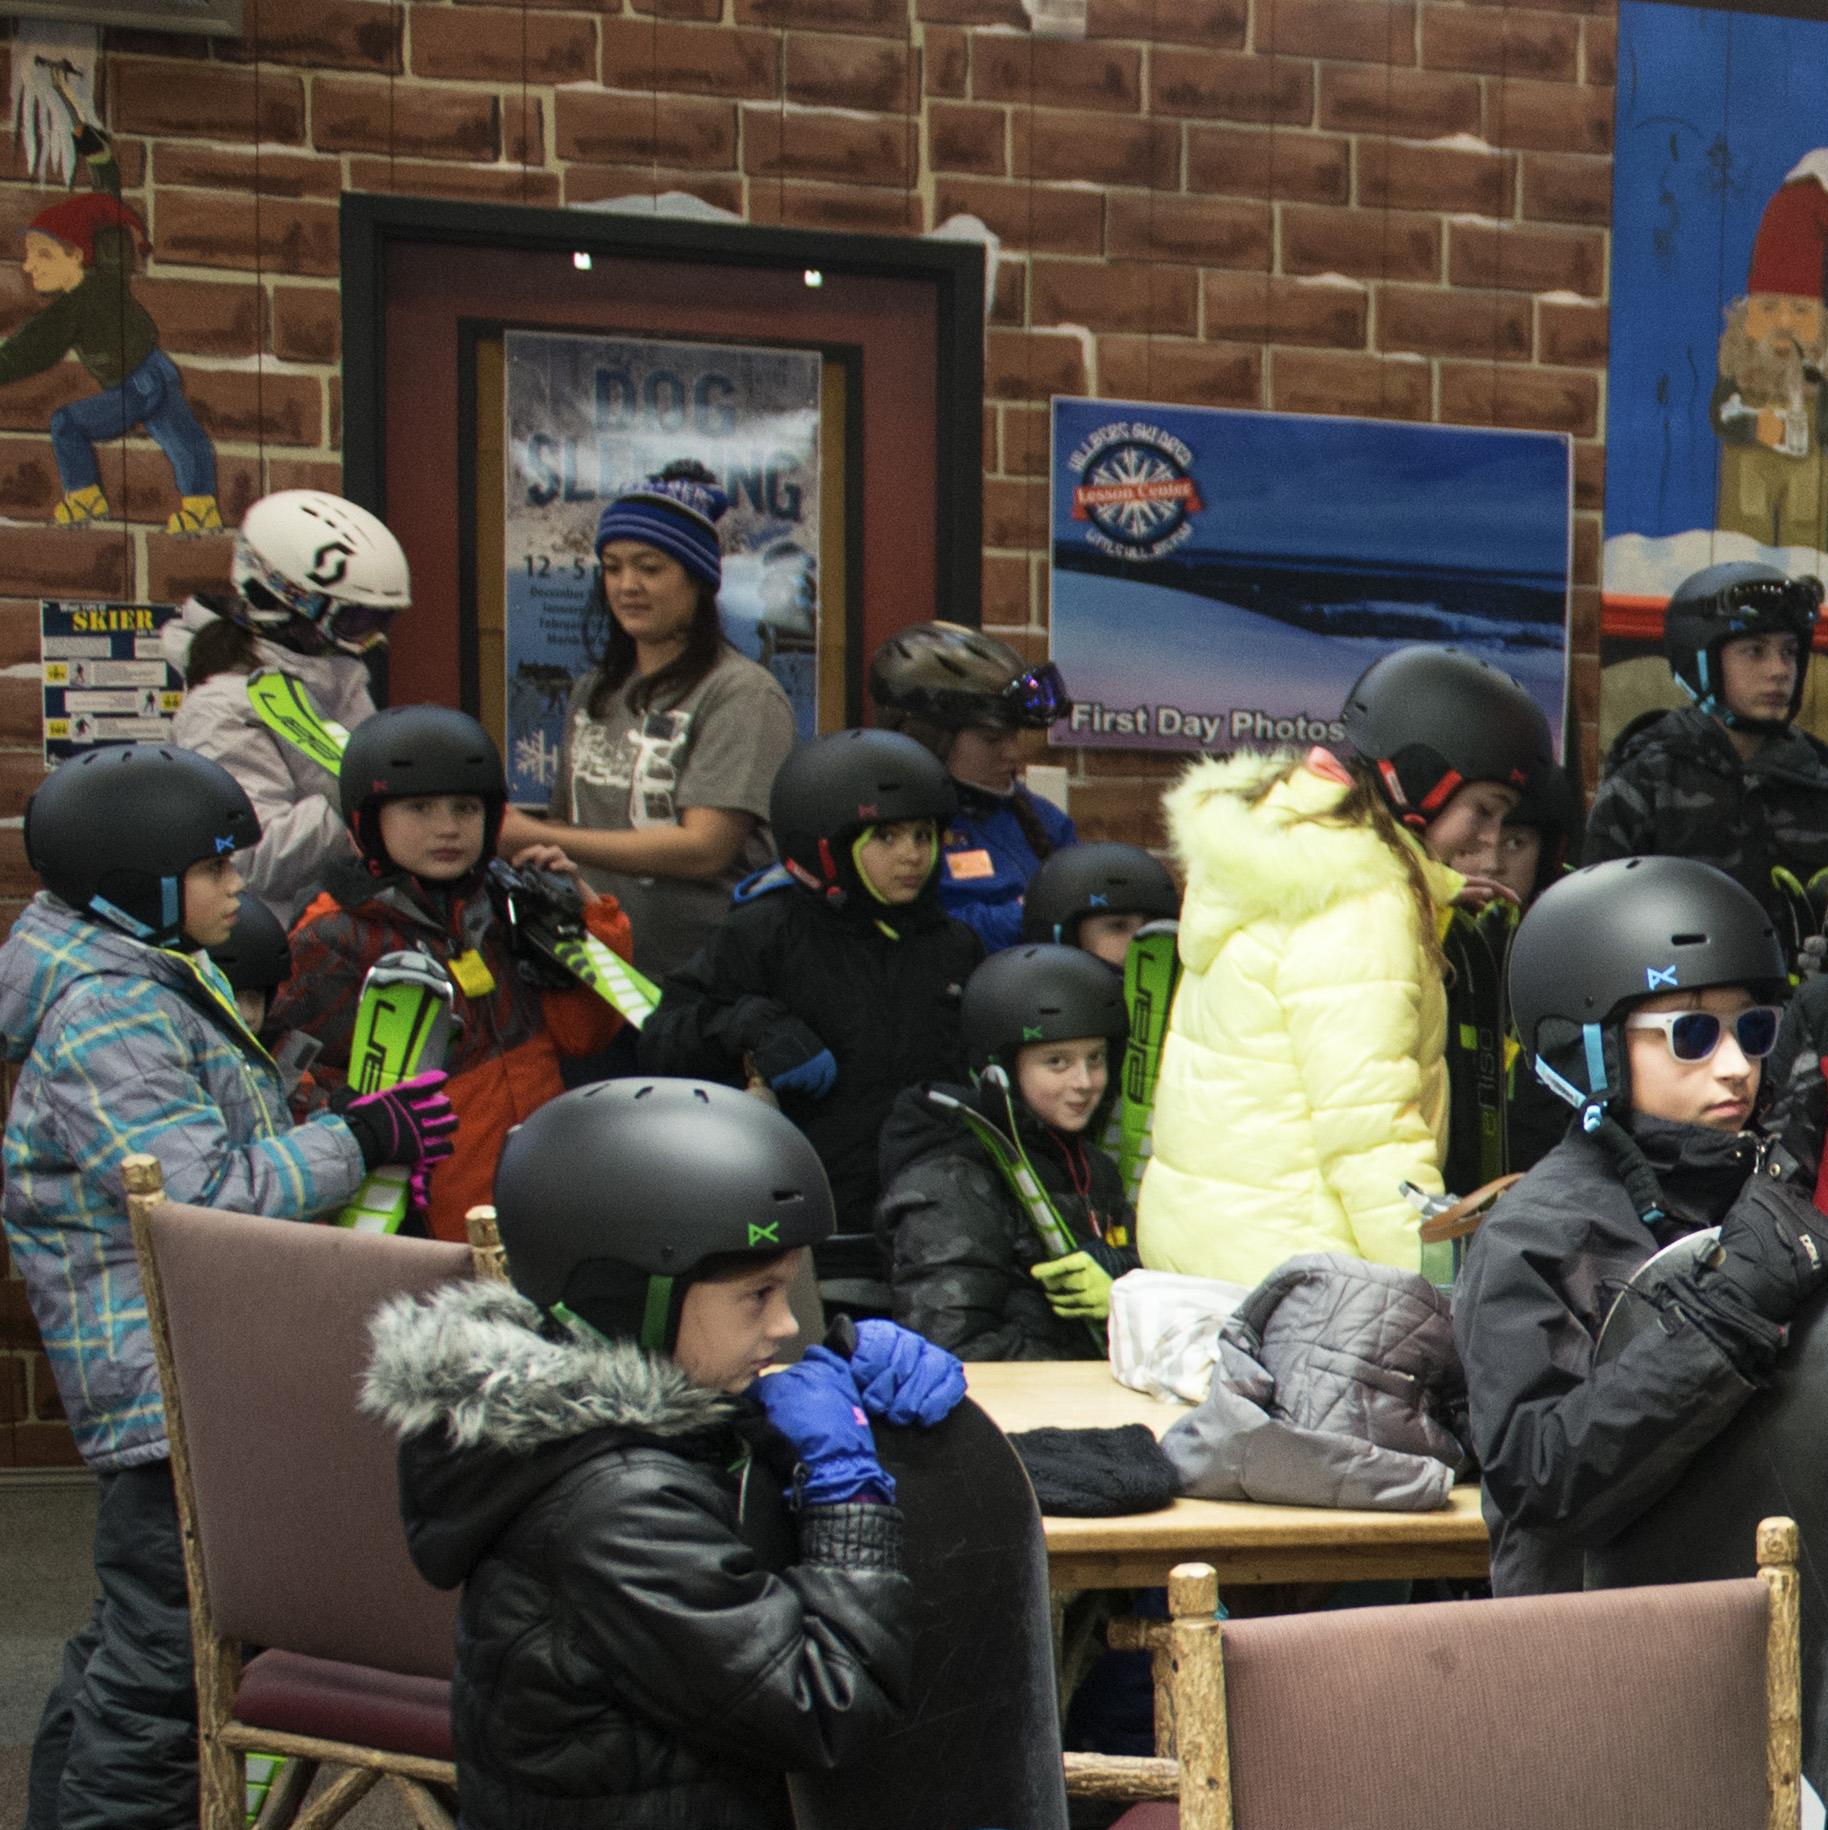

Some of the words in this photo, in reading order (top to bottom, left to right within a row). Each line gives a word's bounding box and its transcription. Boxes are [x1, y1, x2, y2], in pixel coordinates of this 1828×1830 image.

[595, 366, 738, 437] DOG
[1078, 487, 1134, 506] Lesson
[1136, 480, 1193, 500] Center
[524, 554, 551, 578] 12
[573, 557, 586, 580] 5
[72, 609, 155, 632] SKIER
[1070, 702, 1148, 734] First
[1157, 705, 1223, 743] Day
[1230, 708, 1346, 743] Photos
